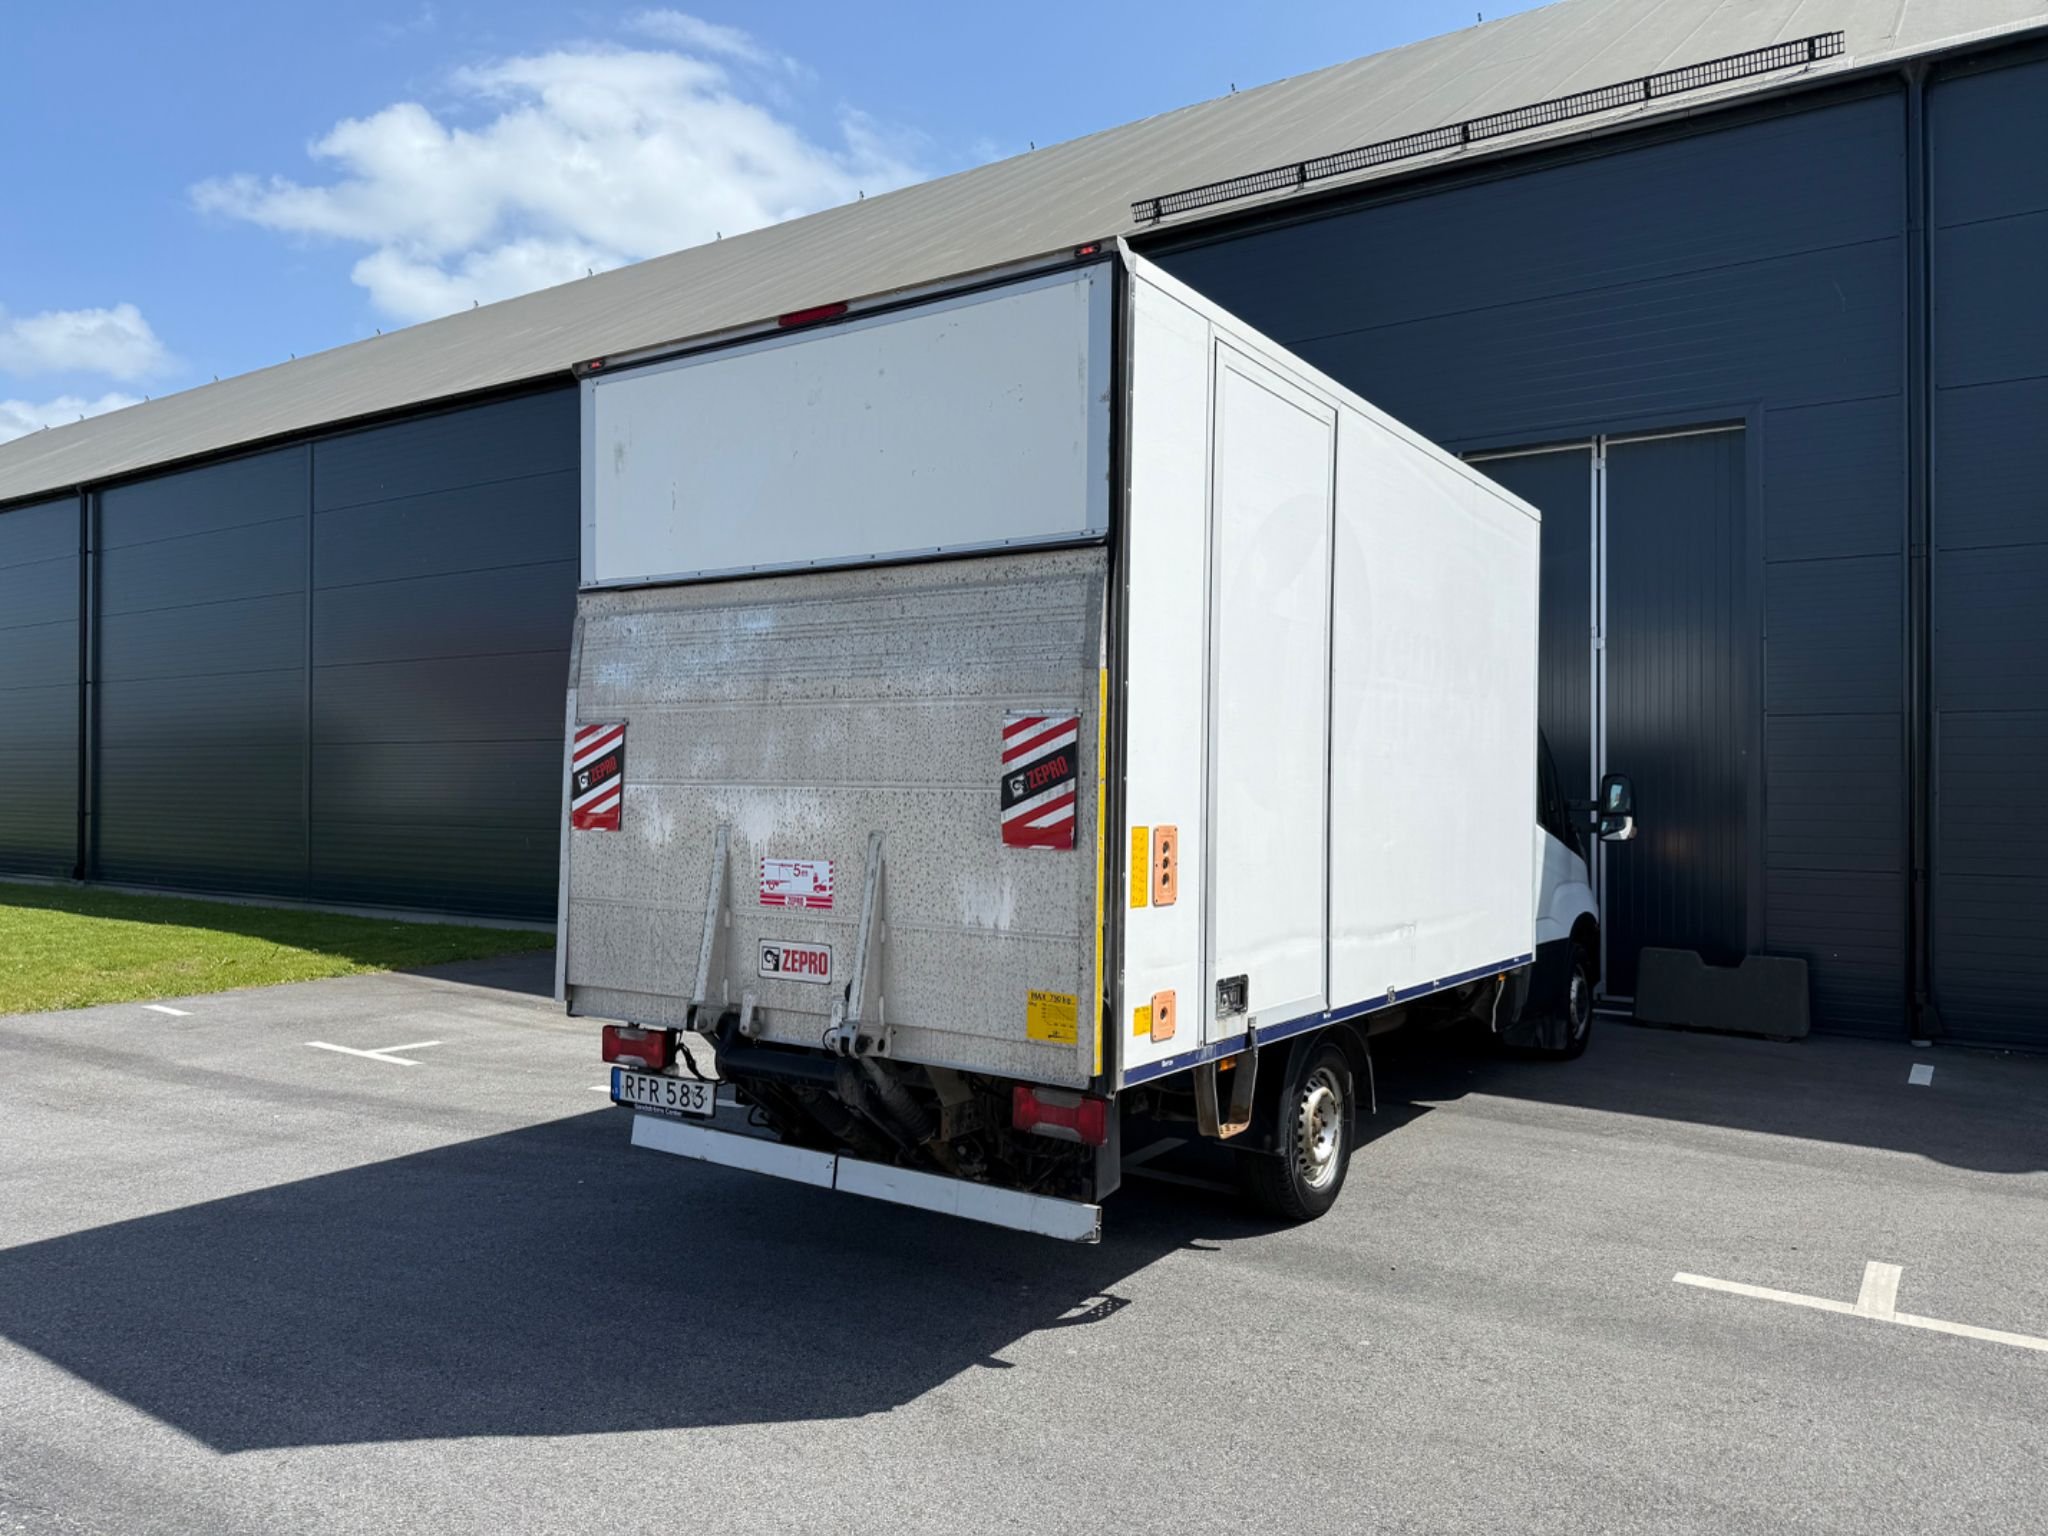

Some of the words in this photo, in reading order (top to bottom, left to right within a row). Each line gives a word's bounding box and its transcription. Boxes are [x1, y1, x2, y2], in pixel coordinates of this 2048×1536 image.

[591, 755, 618, 784] ZEPRO
[1026, 755, 1069, 790] ZEPRO
[781, 948, 829, 976] ZEPRO
[625, 1075, 659, 1103] RFR
[666, 1081, 705, 1109] 583
